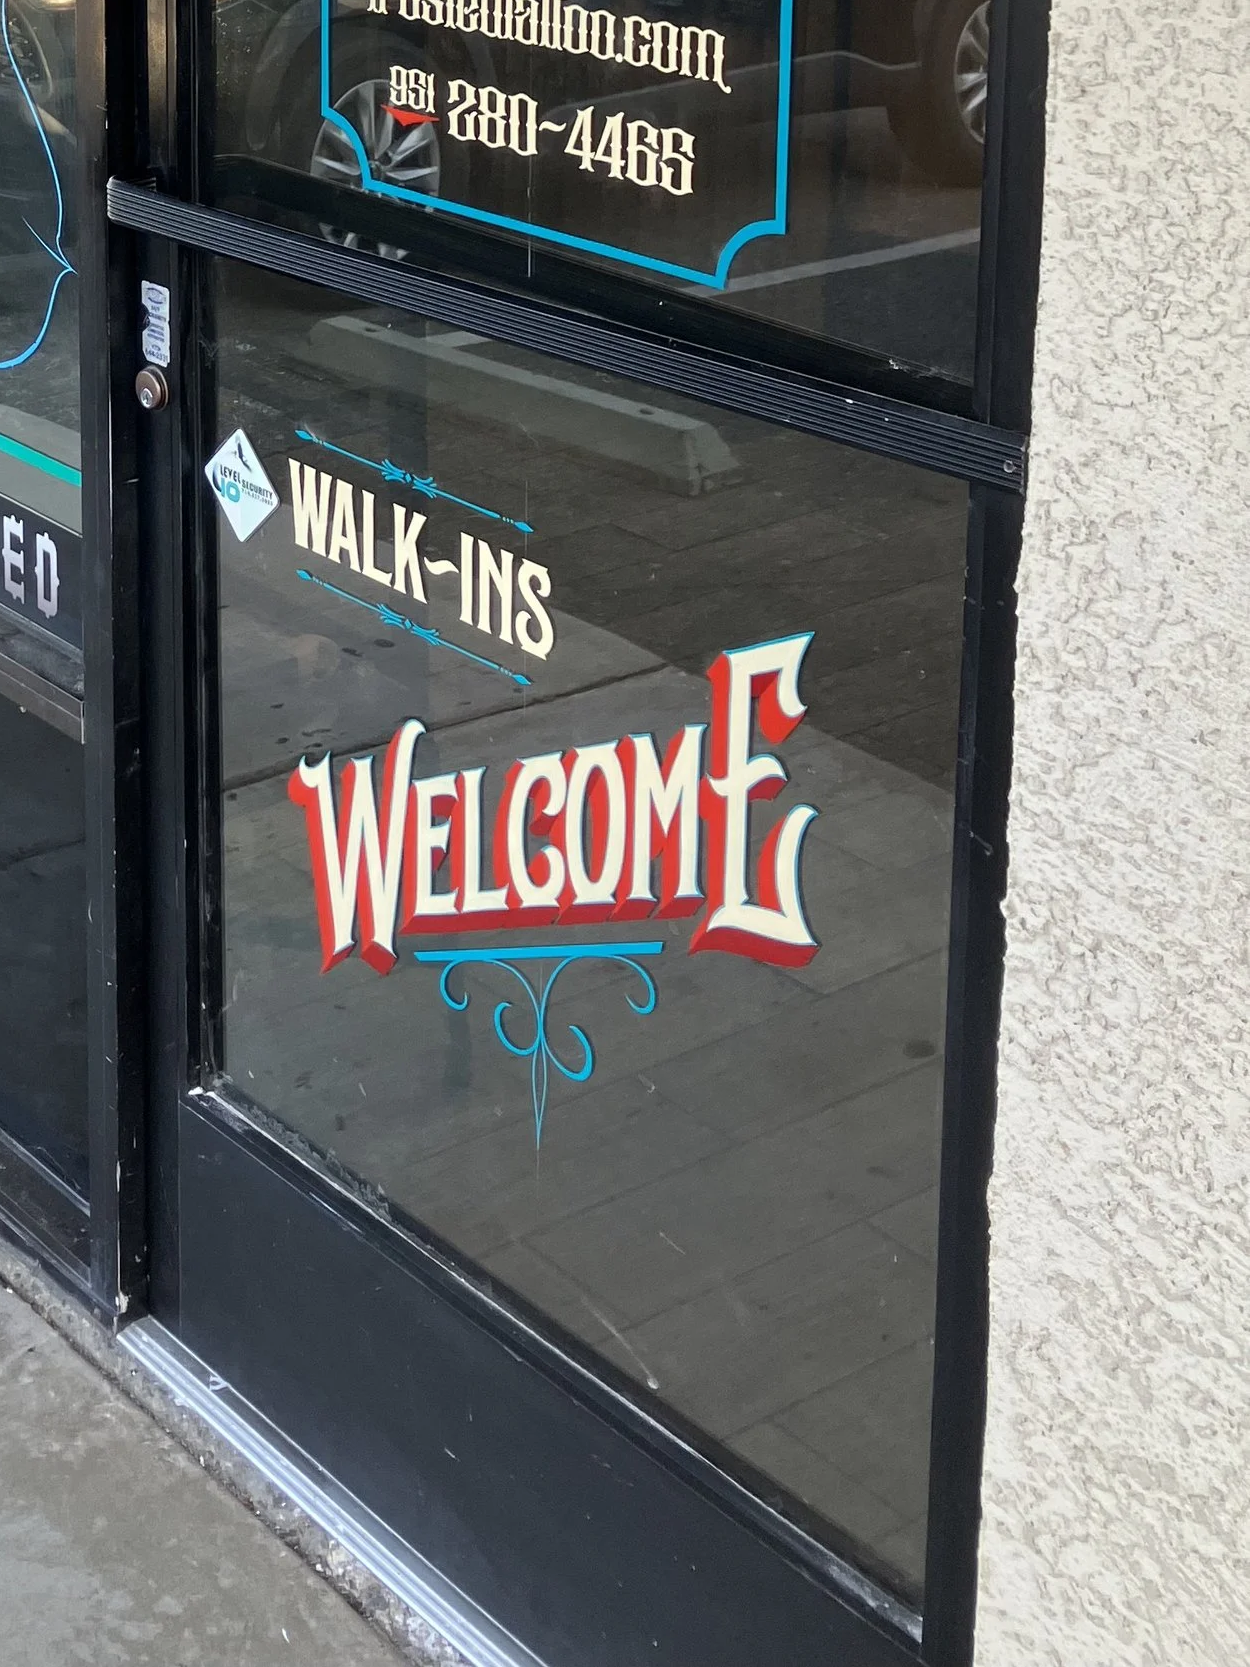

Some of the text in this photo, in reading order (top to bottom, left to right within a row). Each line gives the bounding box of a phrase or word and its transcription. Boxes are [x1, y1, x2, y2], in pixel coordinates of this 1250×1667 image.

[389, 65, 436, 113] 951
[219, 464, 241, 485] LEVEL
[241, 479, 274, 500] SECURITY
[288, 631, 821, 975] WELCOME
